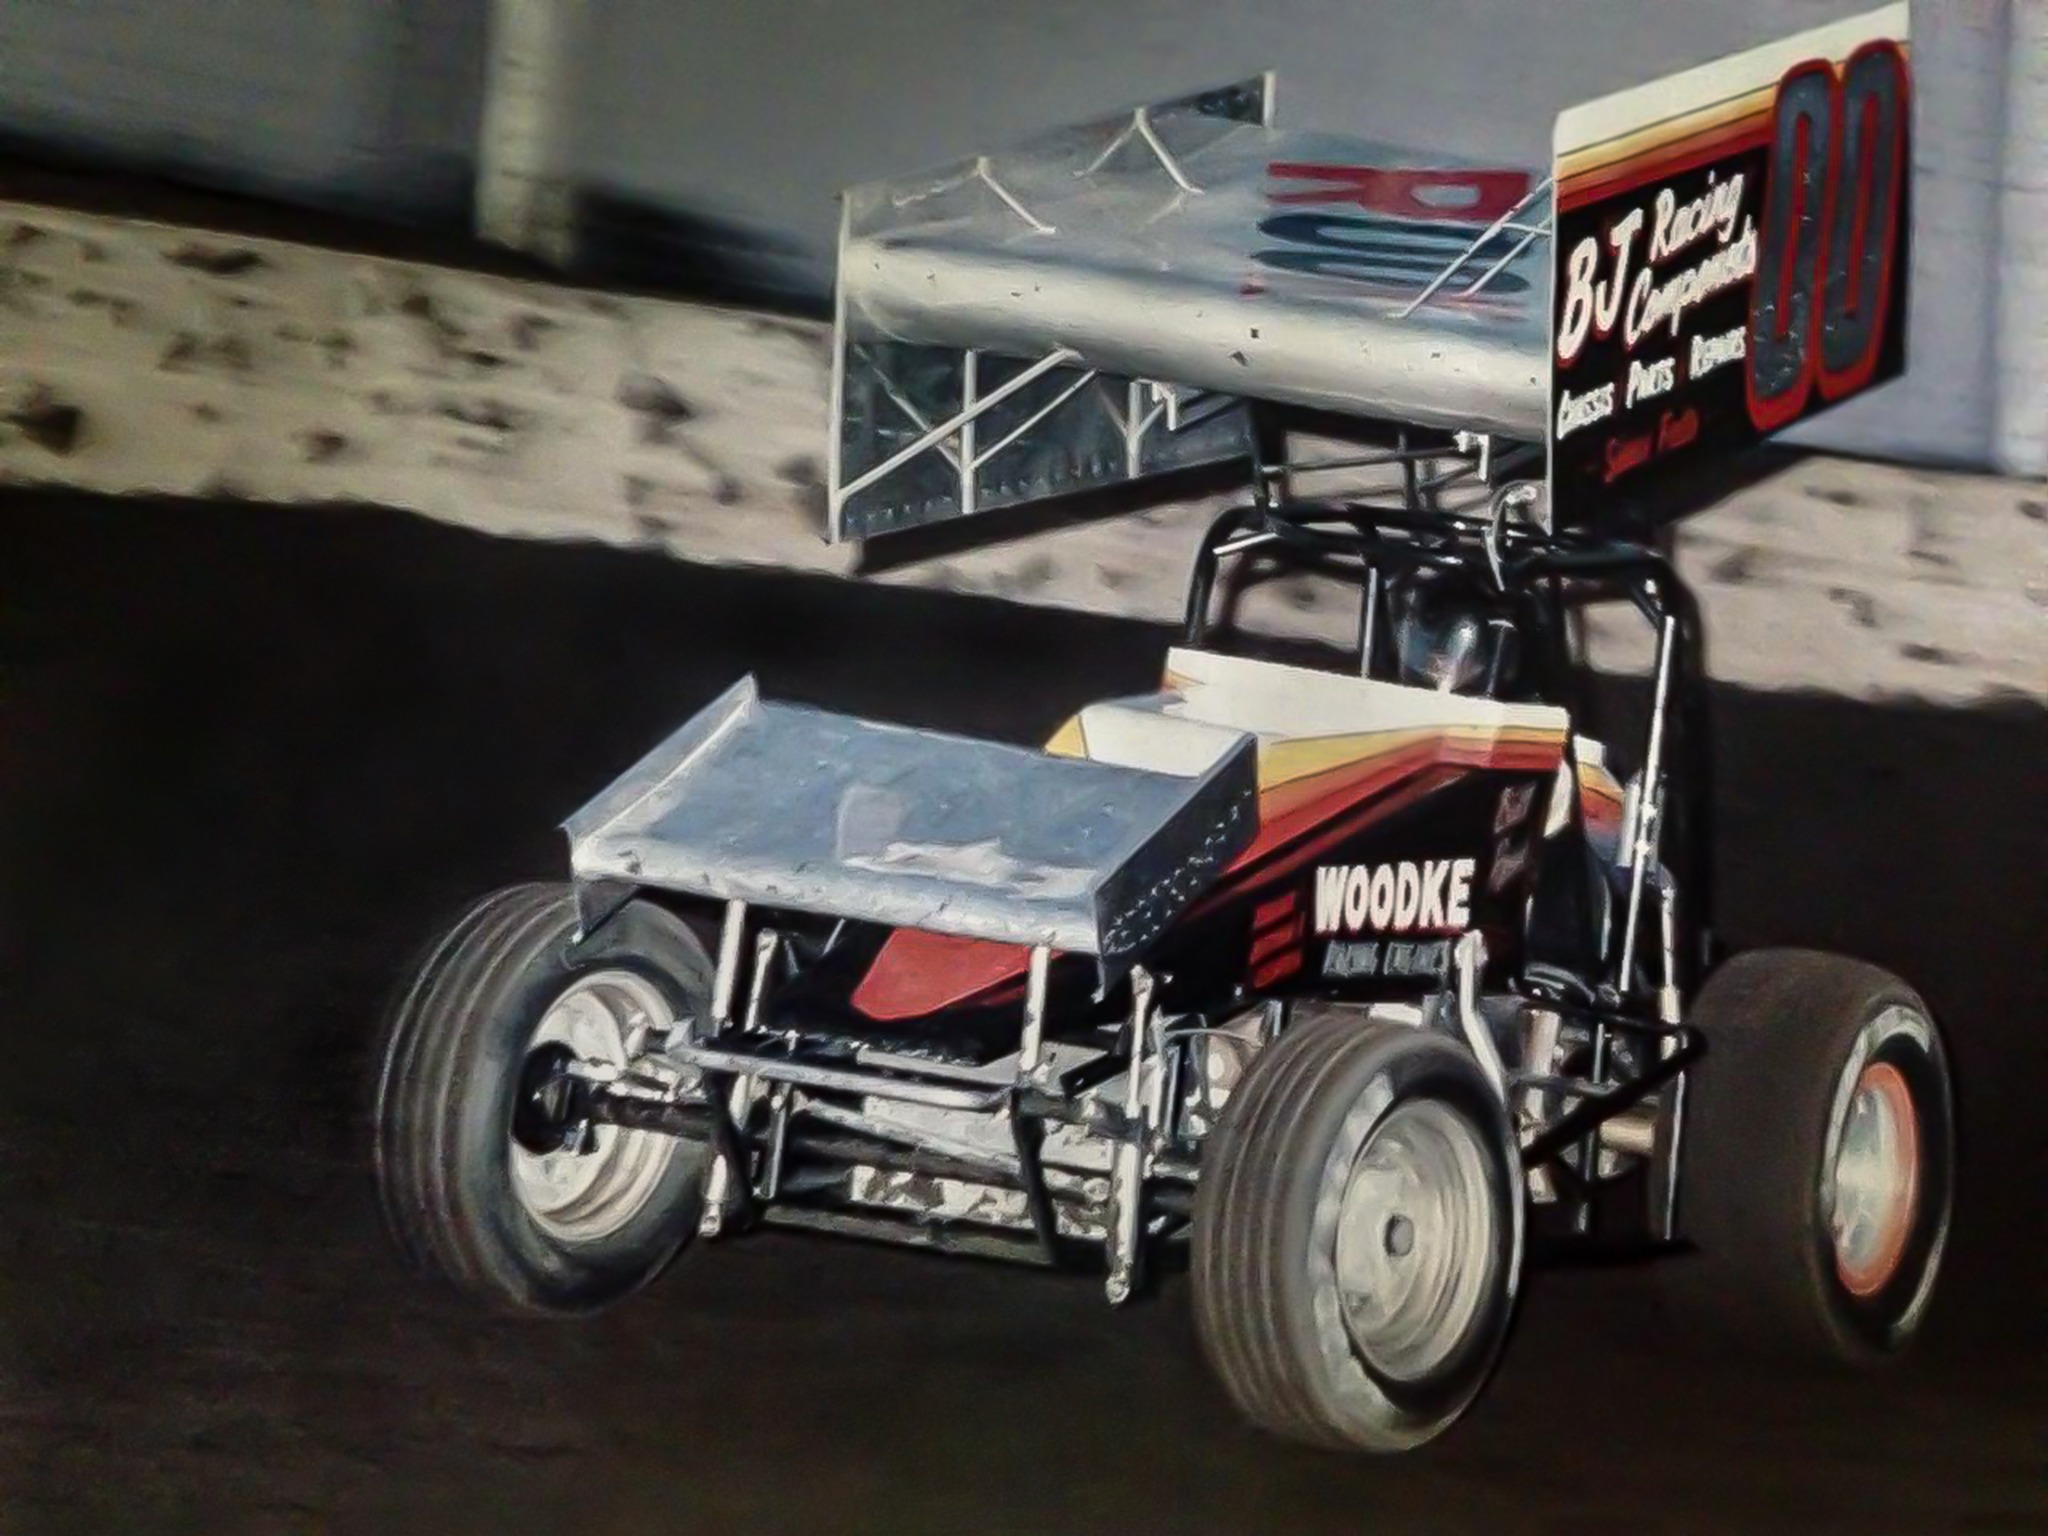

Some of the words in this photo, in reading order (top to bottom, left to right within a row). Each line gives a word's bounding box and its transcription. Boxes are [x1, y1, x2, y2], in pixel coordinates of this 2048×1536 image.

[1557, 207, 1644, 360] BJ
[1747, 39, 1909, 431] 00
[1315, 857, 1476, 934] WOODKE
